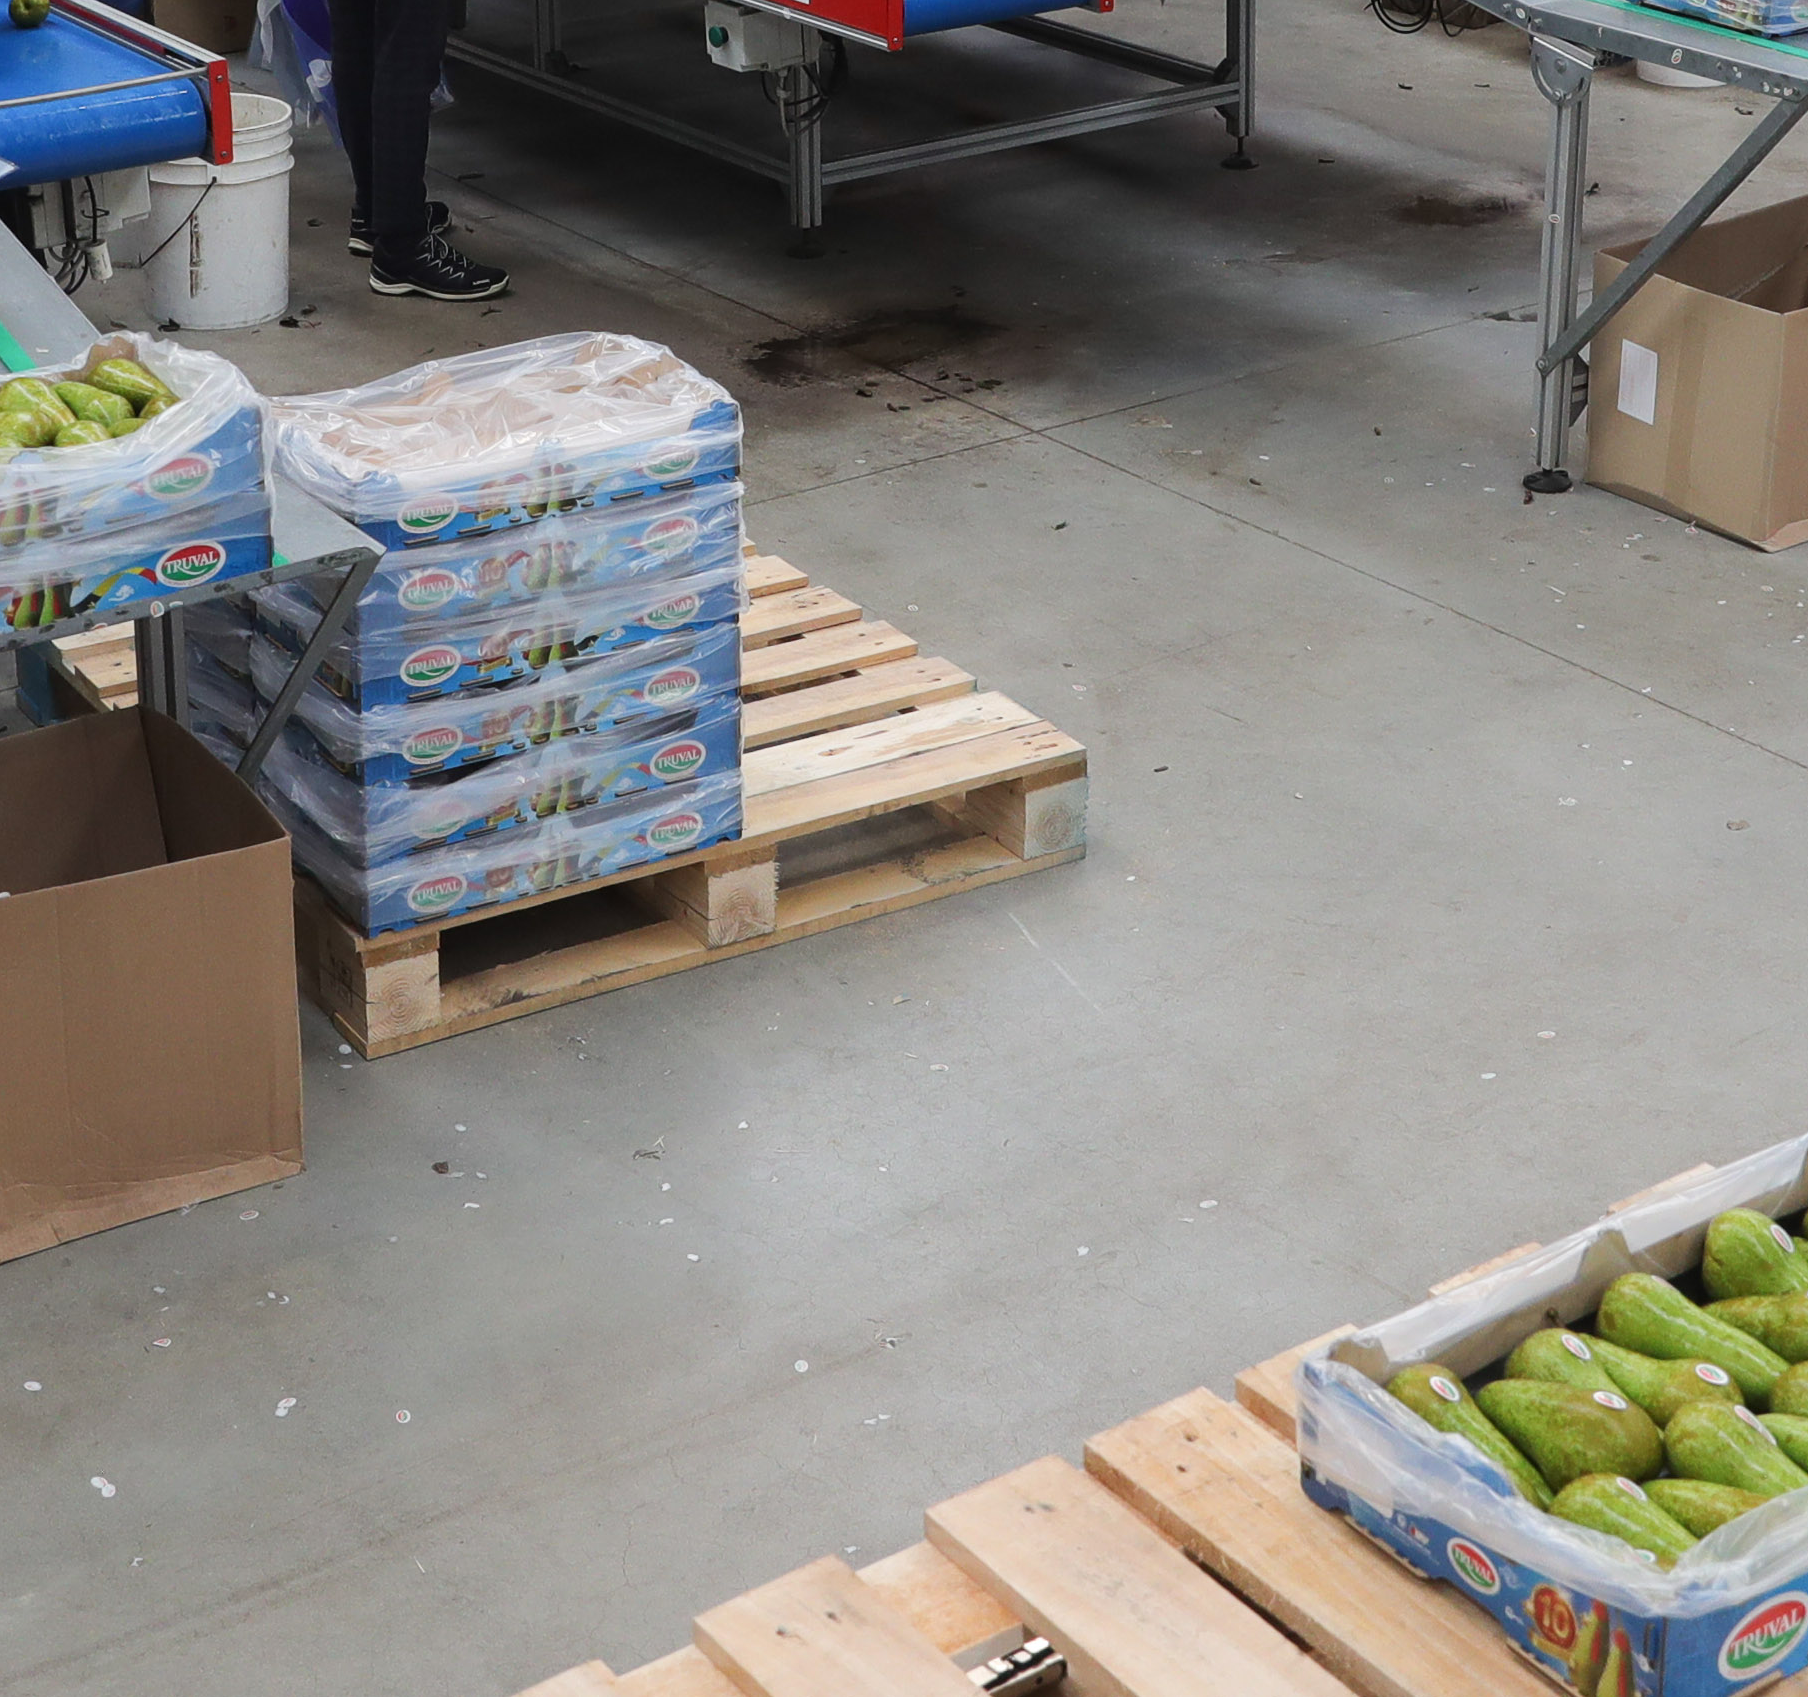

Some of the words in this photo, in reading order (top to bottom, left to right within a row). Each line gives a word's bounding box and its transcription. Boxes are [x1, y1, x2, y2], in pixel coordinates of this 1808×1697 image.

[152, 463, 203, 486] TRUVAL
[164, 551, 218, 575] TRUVAL
[652, 597, 697, 618] TRUVAL
[407, 653, 458, 675] TRUVAL
[652, 676, 695, 695] TRUVAL
[411, 733, 456, 752] TRUVAL
[656, 749, 700, 769] TRUVAL
[654, 820, 700, 840] TRUVAL
[415, 879, 460, 901] TRUVAL
[1454, 1549, 1494, 1584] TRUVAL
[1542, 1588, 1573, 1641] 10
[1730, 1605, 1804, 1661] TRUVAL
